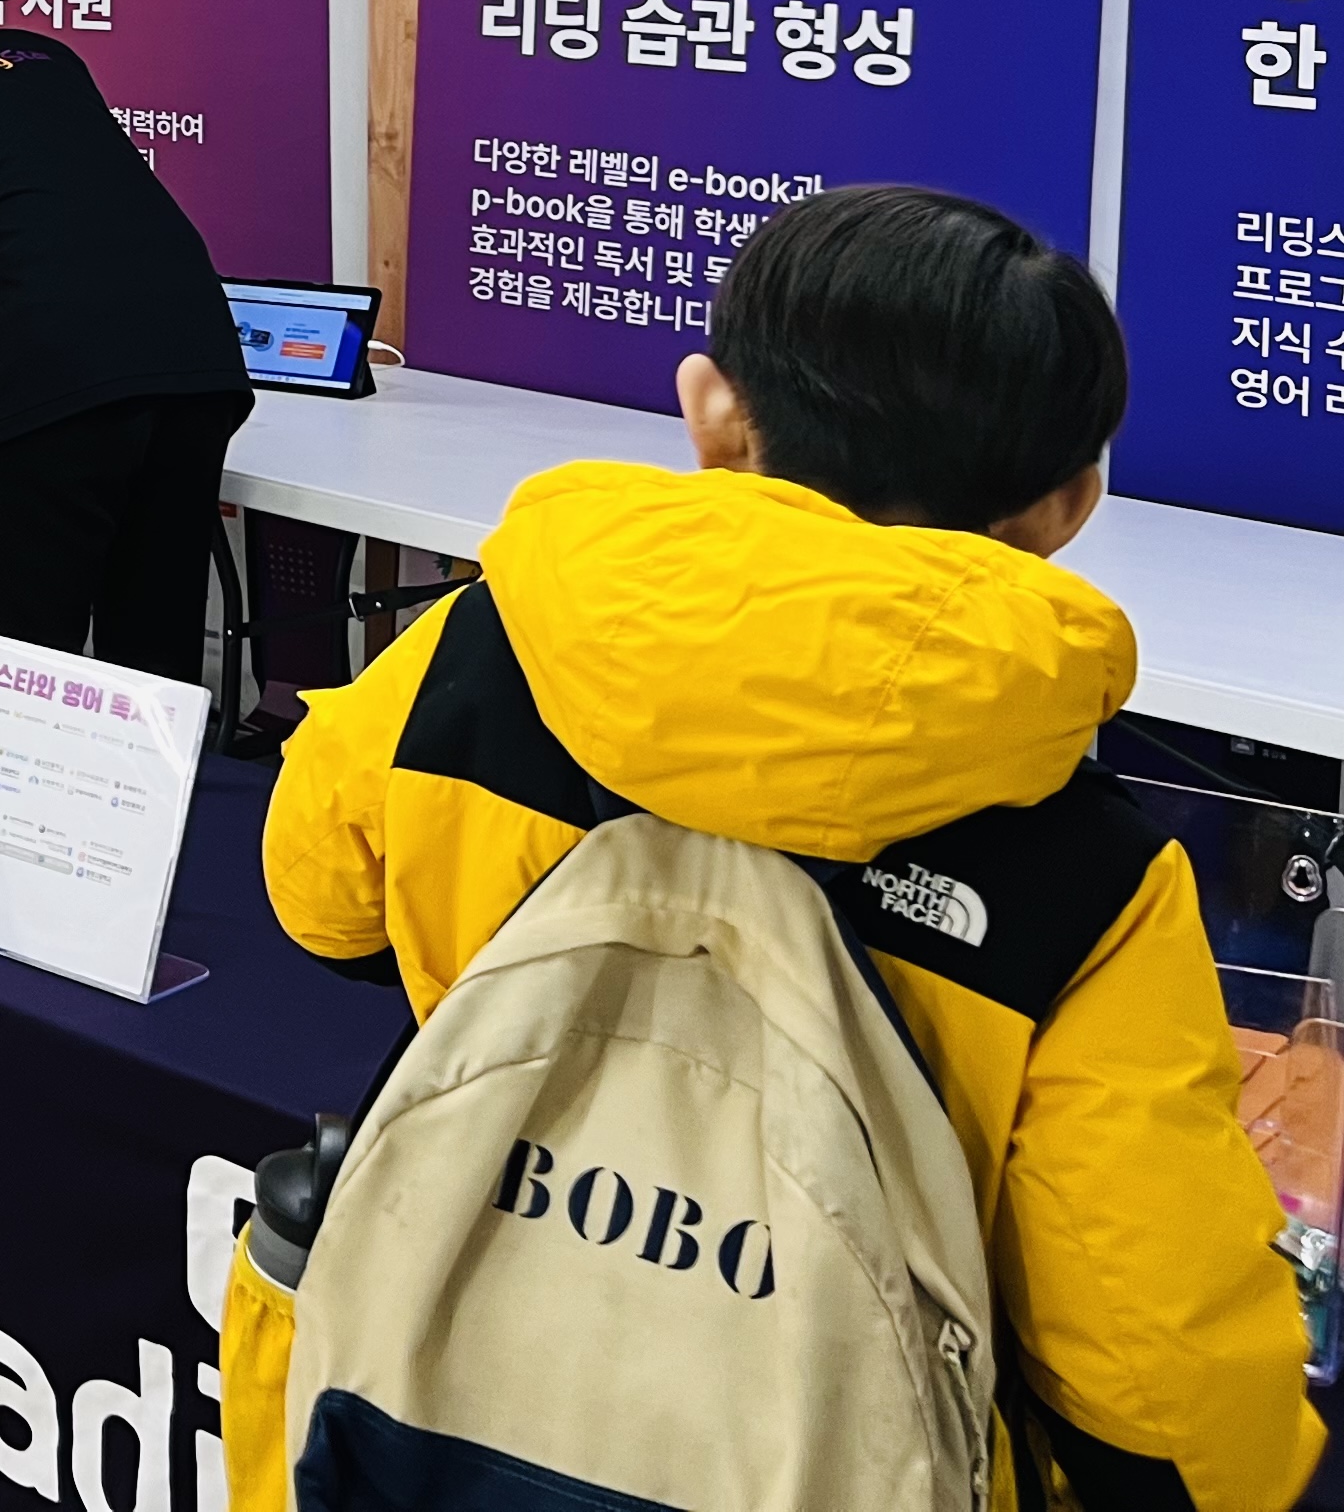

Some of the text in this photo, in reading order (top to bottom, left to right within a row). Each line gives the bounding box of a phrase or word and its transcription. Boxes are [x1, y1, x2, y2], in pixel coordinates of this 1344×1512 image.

[774, 0, 914, 87] 형성
[1240, 22, 1327, 110] 한
[474, 138, 561, 179] 다양한
[569, 149, 658, 191] 레벨의
[471, 187, 771, 248] p-book을 통해 학생
[470, 224, 693, 288] 효과적인 독서 및
[469, 267, 712, 336] 경험을 제공합니다
[1231, 316, 1312, 365] 지식
[1231, 367, 1310, 417] 영어
[62, 679, 103, 714] 영어
[862, 866, 949, 911] NORTH
[908, 863, 954, 894] THE
[881, 893, 942, 928] FACE
[491, 1139, 778, 1300] BOBO
